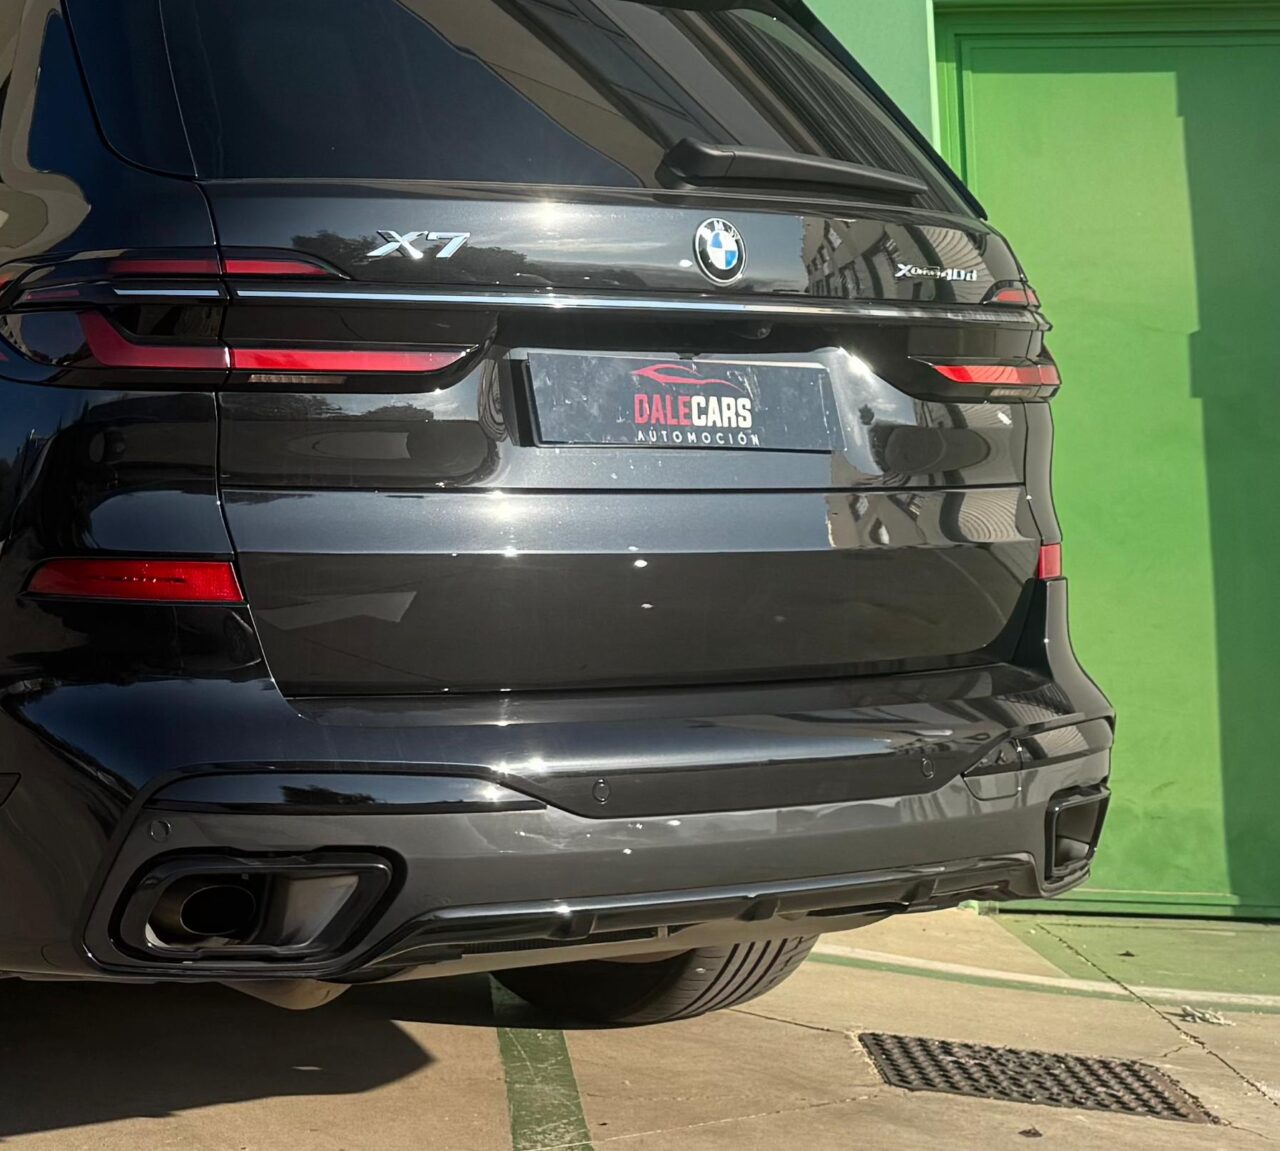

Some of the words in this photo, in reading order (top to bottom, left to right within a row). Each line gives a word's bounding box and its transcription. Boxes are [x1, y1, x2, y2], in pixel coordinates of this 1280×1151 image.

[365, 229, 471, 260] X7
[633, 393, 753, 429] DALECARS
[637, 429, 761, 447] AUTOMOCIÓN
